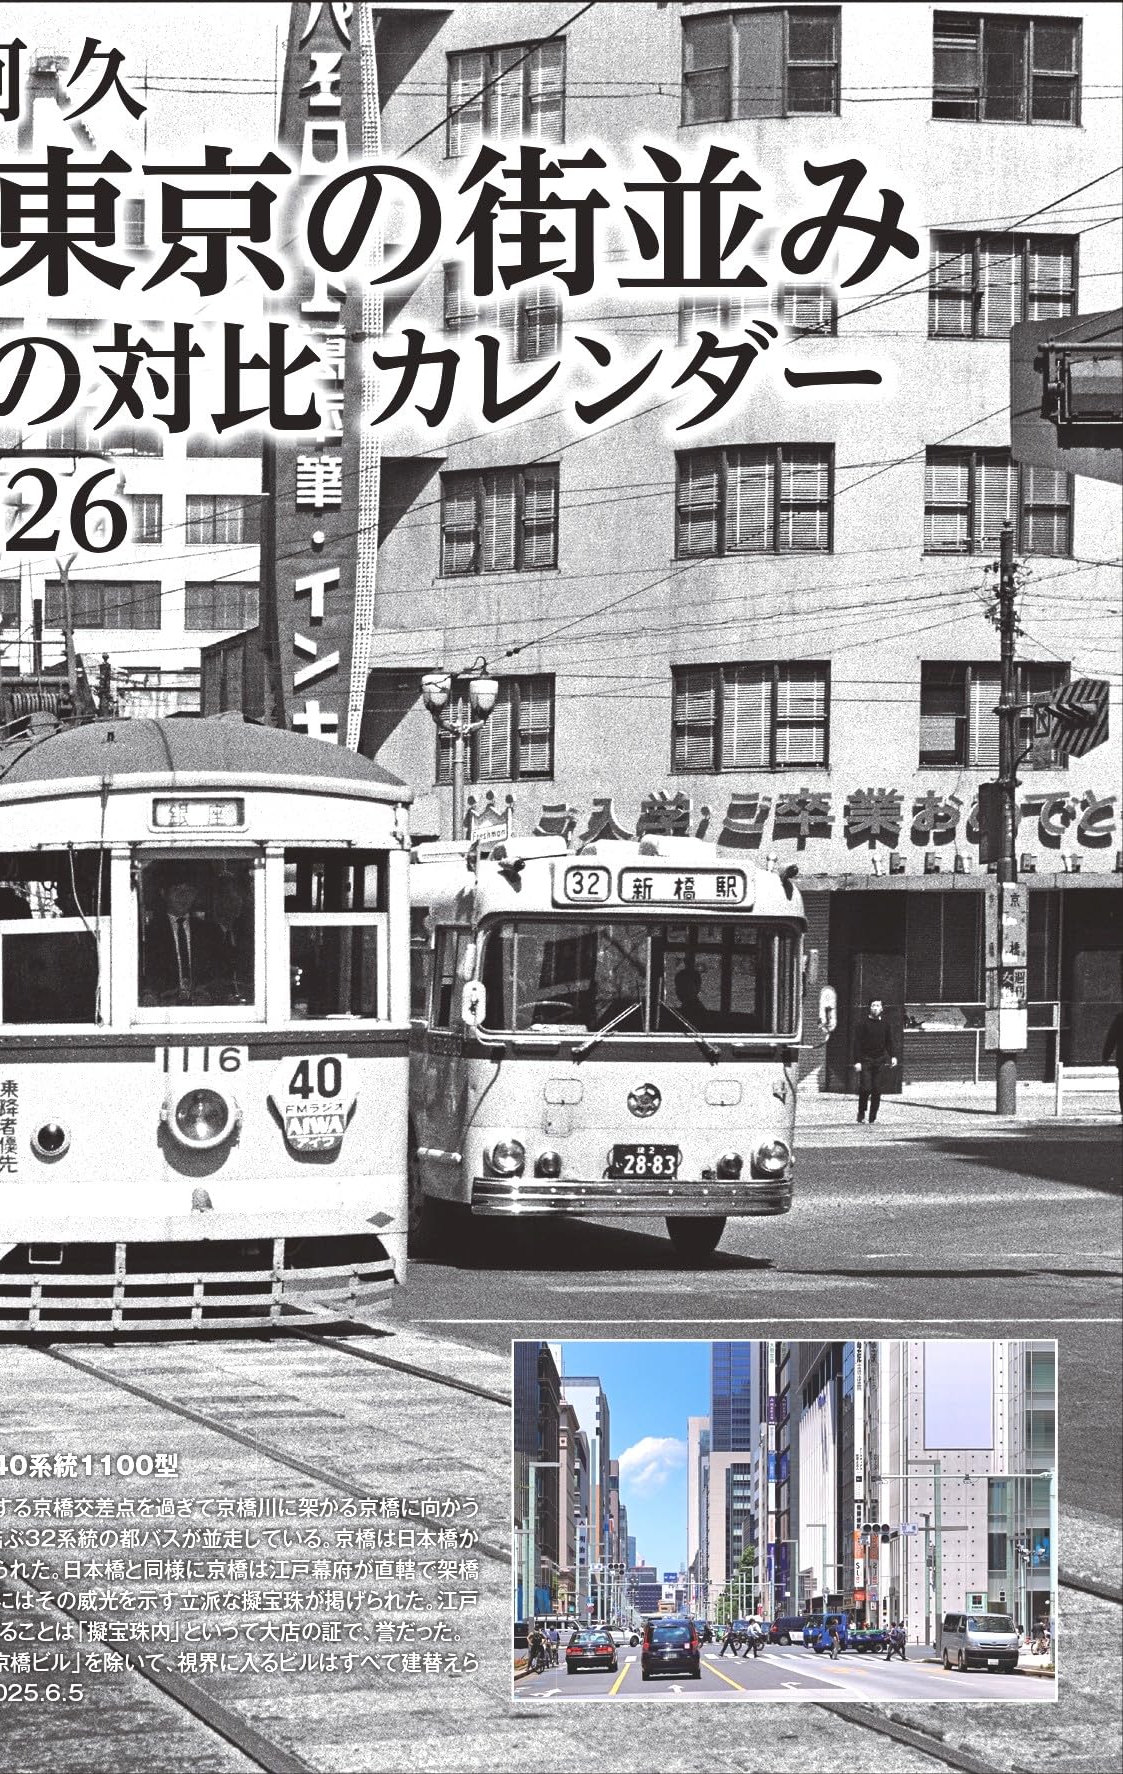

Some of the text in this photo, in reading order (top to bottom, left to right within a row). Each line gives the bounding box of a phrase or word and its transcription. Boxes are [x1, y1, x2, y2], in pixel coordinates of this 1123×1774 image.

[571, 871, 600, 896] 32
[631, 876, 738, 901] 新橋駅
[162, 1046, 241, 1073] 1116
[289, 1056, 342, 1099] 40
[286, 1102, 344, 1114] FMラジオ
[287, 1115, 345, 1136] AIWA
[623, 1154, 676, 1175] 28-83
